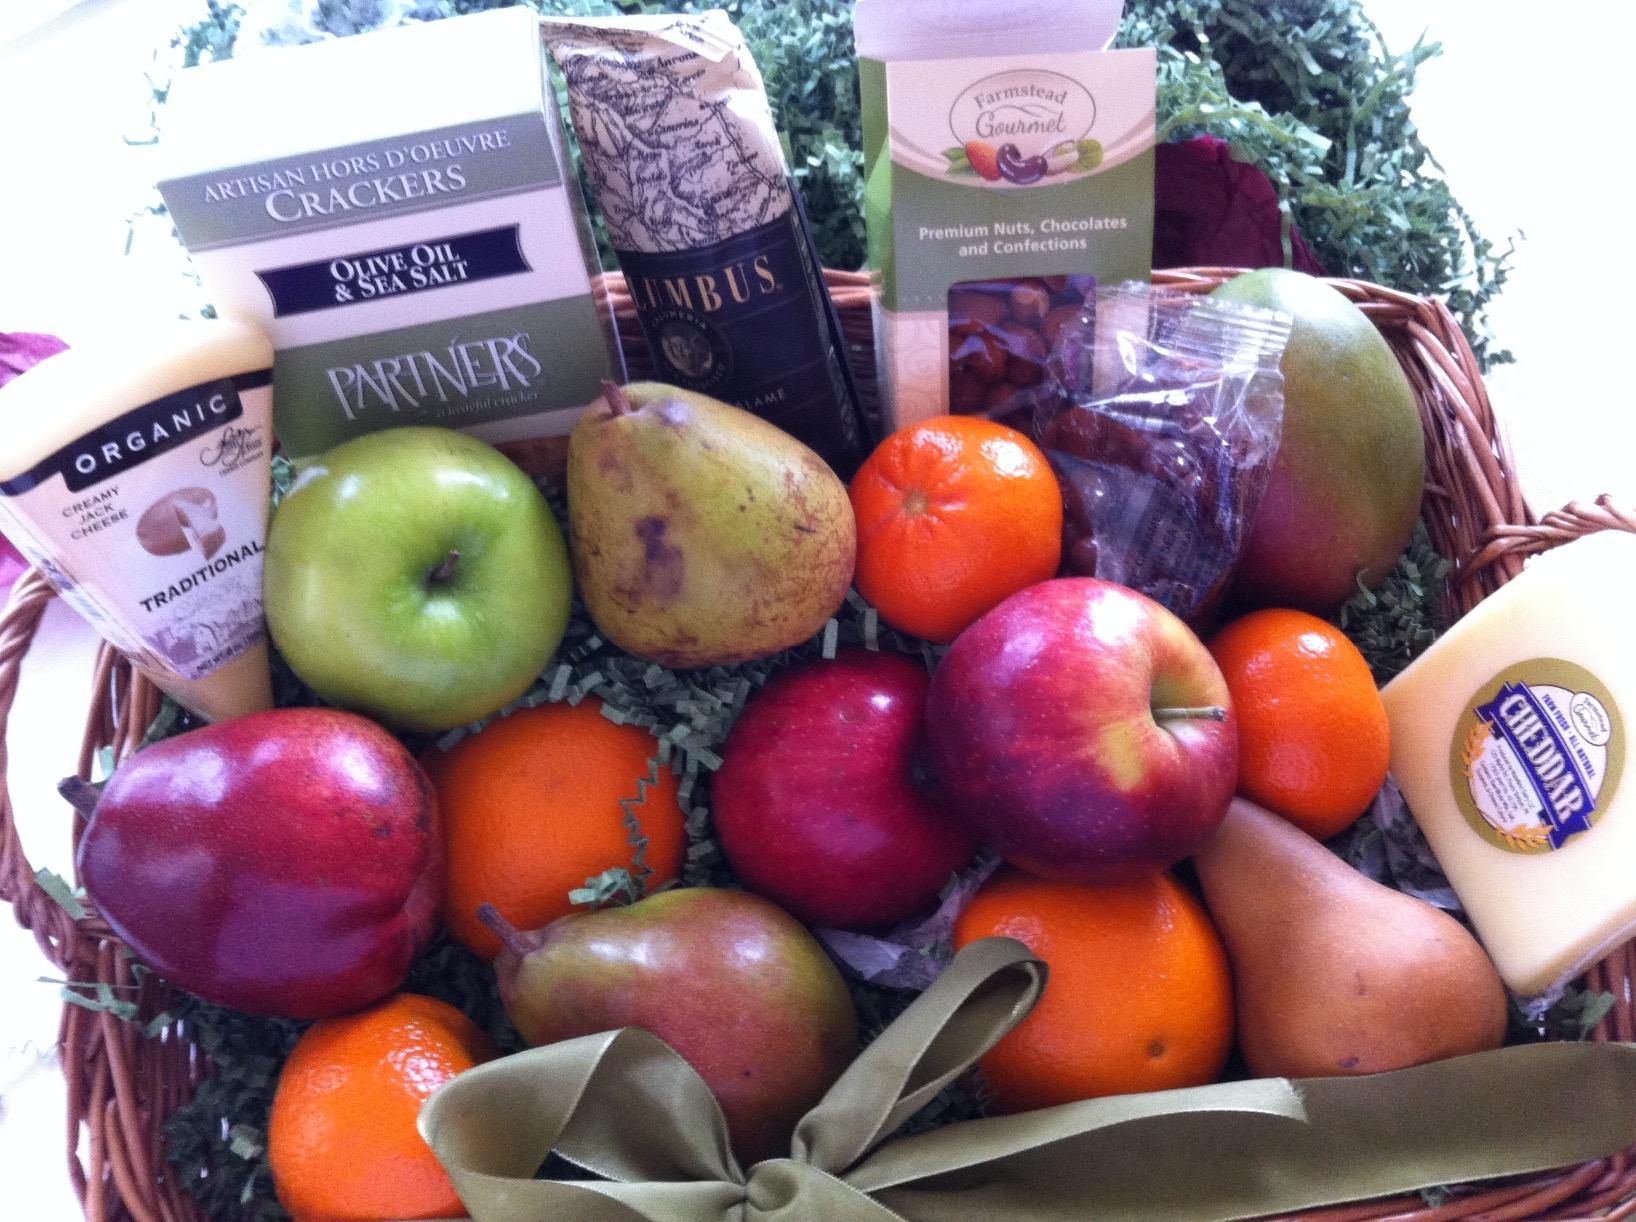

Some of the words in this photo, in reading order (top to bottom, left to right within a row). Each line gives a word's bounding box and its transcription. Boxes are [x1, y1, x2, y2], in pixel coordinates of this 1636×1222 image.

[973, 84, 1068, 109] Farmstead
[975, 110, 1067, 139] Gourmet
[203, 167, 306, 203] ARTISAN
[313, 152, 381, 181] HORS
[386, 129, 511, 169] D'OEUVRE
[264, 163, 467, 224] CRACKERS
[918, 224, 990, 241] Premium
[994, 221, 1035, 237] Nuts,
[1040, 216, 1128, 234] Chocolates
[958, 242, 988, 257] and
[993, 237, 1087, 255] Confections
[329, 248, 408, 282] OLIVE
[411, 243, 460, 269] OIL
[334, 283, 354, 302] &
[360, 274, 409, 298] SEA
[414, 259, 468, 288] SALT
[74, 392, 228, 475] ORGANIC
[61, 485, 121, 519] CREAMY
[79, 503, 115, 526] JACK
[70, 509, 130, 541] CHEESE
[138, 539, 266, 614] TRADITIONAL
[1541, 694, 1559, 718] FARM
[1554, 712, 1571, 735] FRESH
[1567, 735, 1579, 750] ALL
[1575, 747, 1597, 780] NATURAL
[1499, 692, 1586, 823] CHEDDAR
